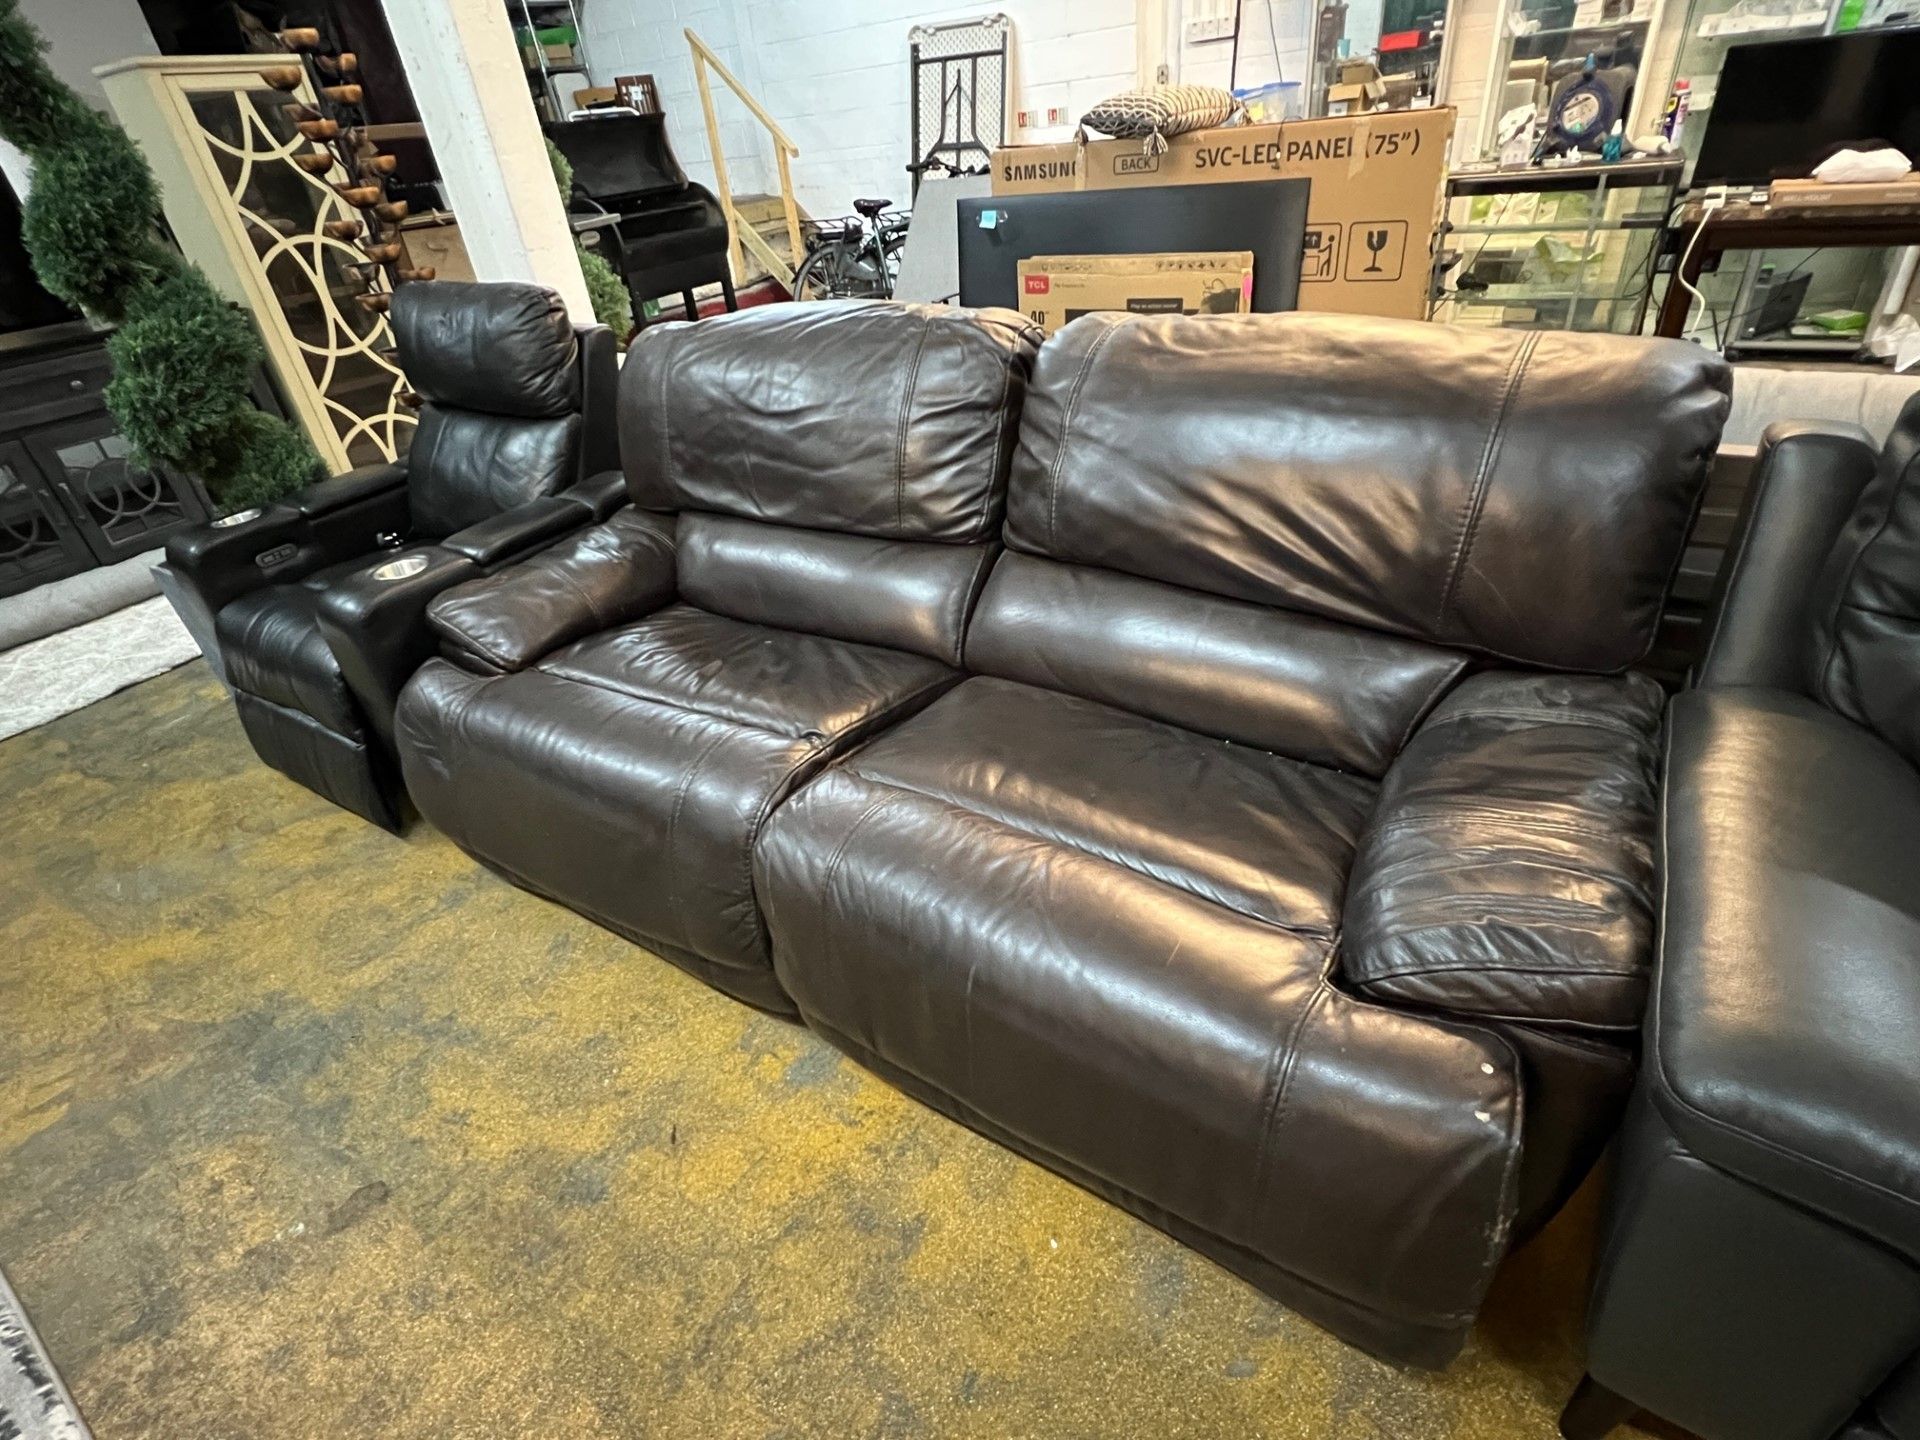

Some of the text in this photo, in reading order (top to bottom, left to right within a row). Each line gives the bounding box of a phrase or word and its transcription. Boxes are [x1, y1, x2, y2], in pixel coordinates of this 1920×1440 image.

[1195, 142, 1281, 168] SVC-LED
[1120, 157, 1151, 171] BACK
[1027, 280, 1046, 290] TCL
